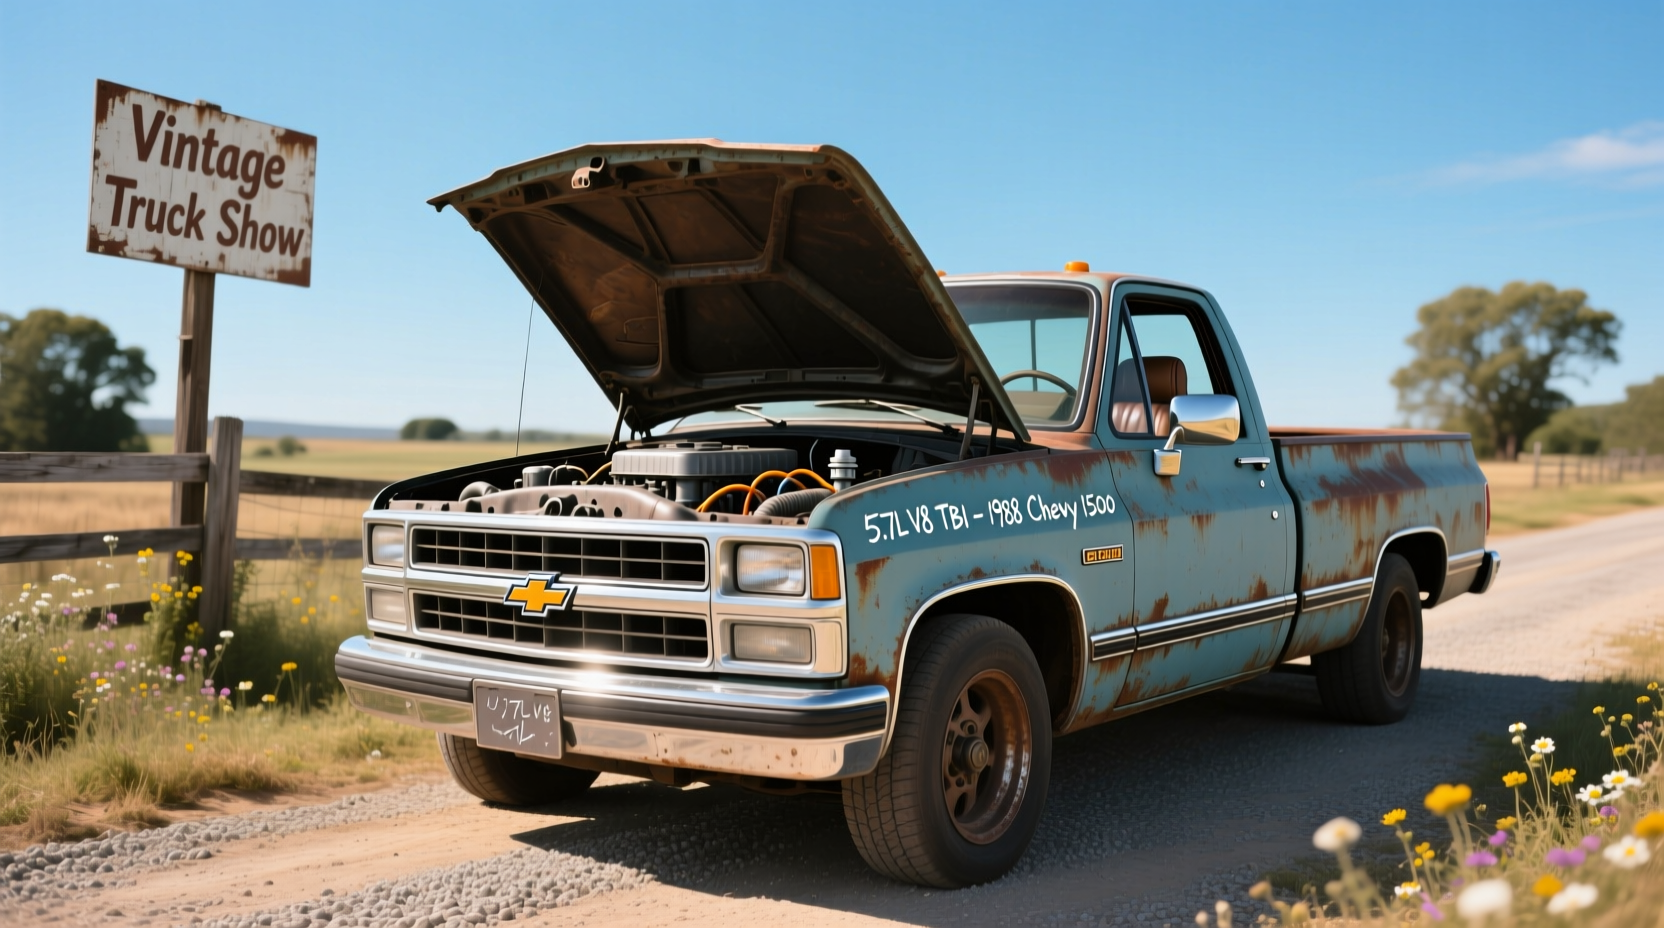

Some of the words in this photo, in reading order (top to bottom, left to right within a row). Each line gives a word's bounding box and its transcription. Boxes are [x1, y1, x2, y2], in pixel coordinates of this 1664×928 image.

[132, 104, 285, 200] Vintage
[105, 174, 206, 241] Truck
[216, 199, 304, 257] Show
[934, 503, 969, 530] TBI
[988, 497, 1023, 528] 1988
[1026, 494, 1077, 530] Chevy
[1080, 493, 1116, 517] 1500
